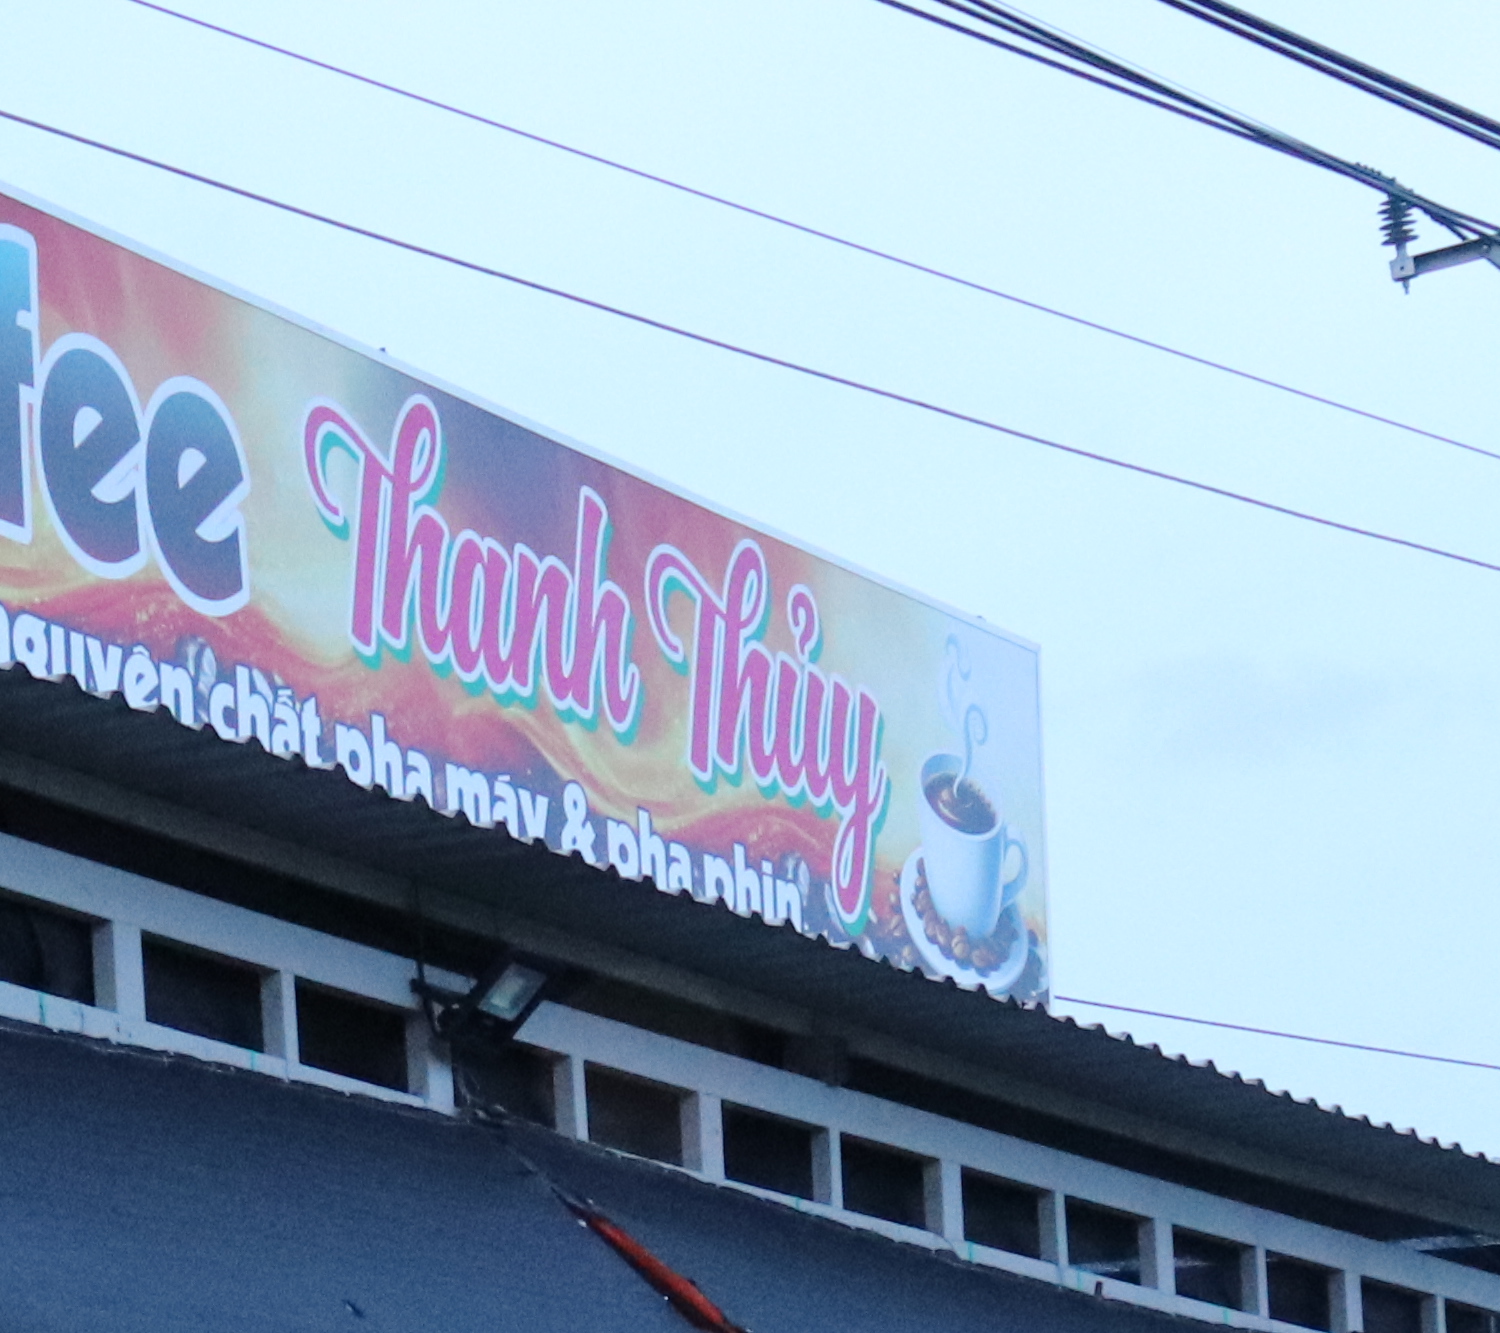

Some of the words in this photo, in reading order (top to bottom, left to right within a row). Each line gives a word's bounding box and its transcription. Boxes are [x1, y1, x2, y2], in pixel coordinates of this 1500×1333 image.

[206, 671, 321, 769] chất
[335, 712, 433, 801] pha
[445, 758, 548, 843] máy
[561, 783, 597, 863] &
[605, 808, 693, 896] pha
[703, 840, 804, 931] phin
[302, 394, 640, 740] Thanh
[644, 538, 890, 935] Thủy
